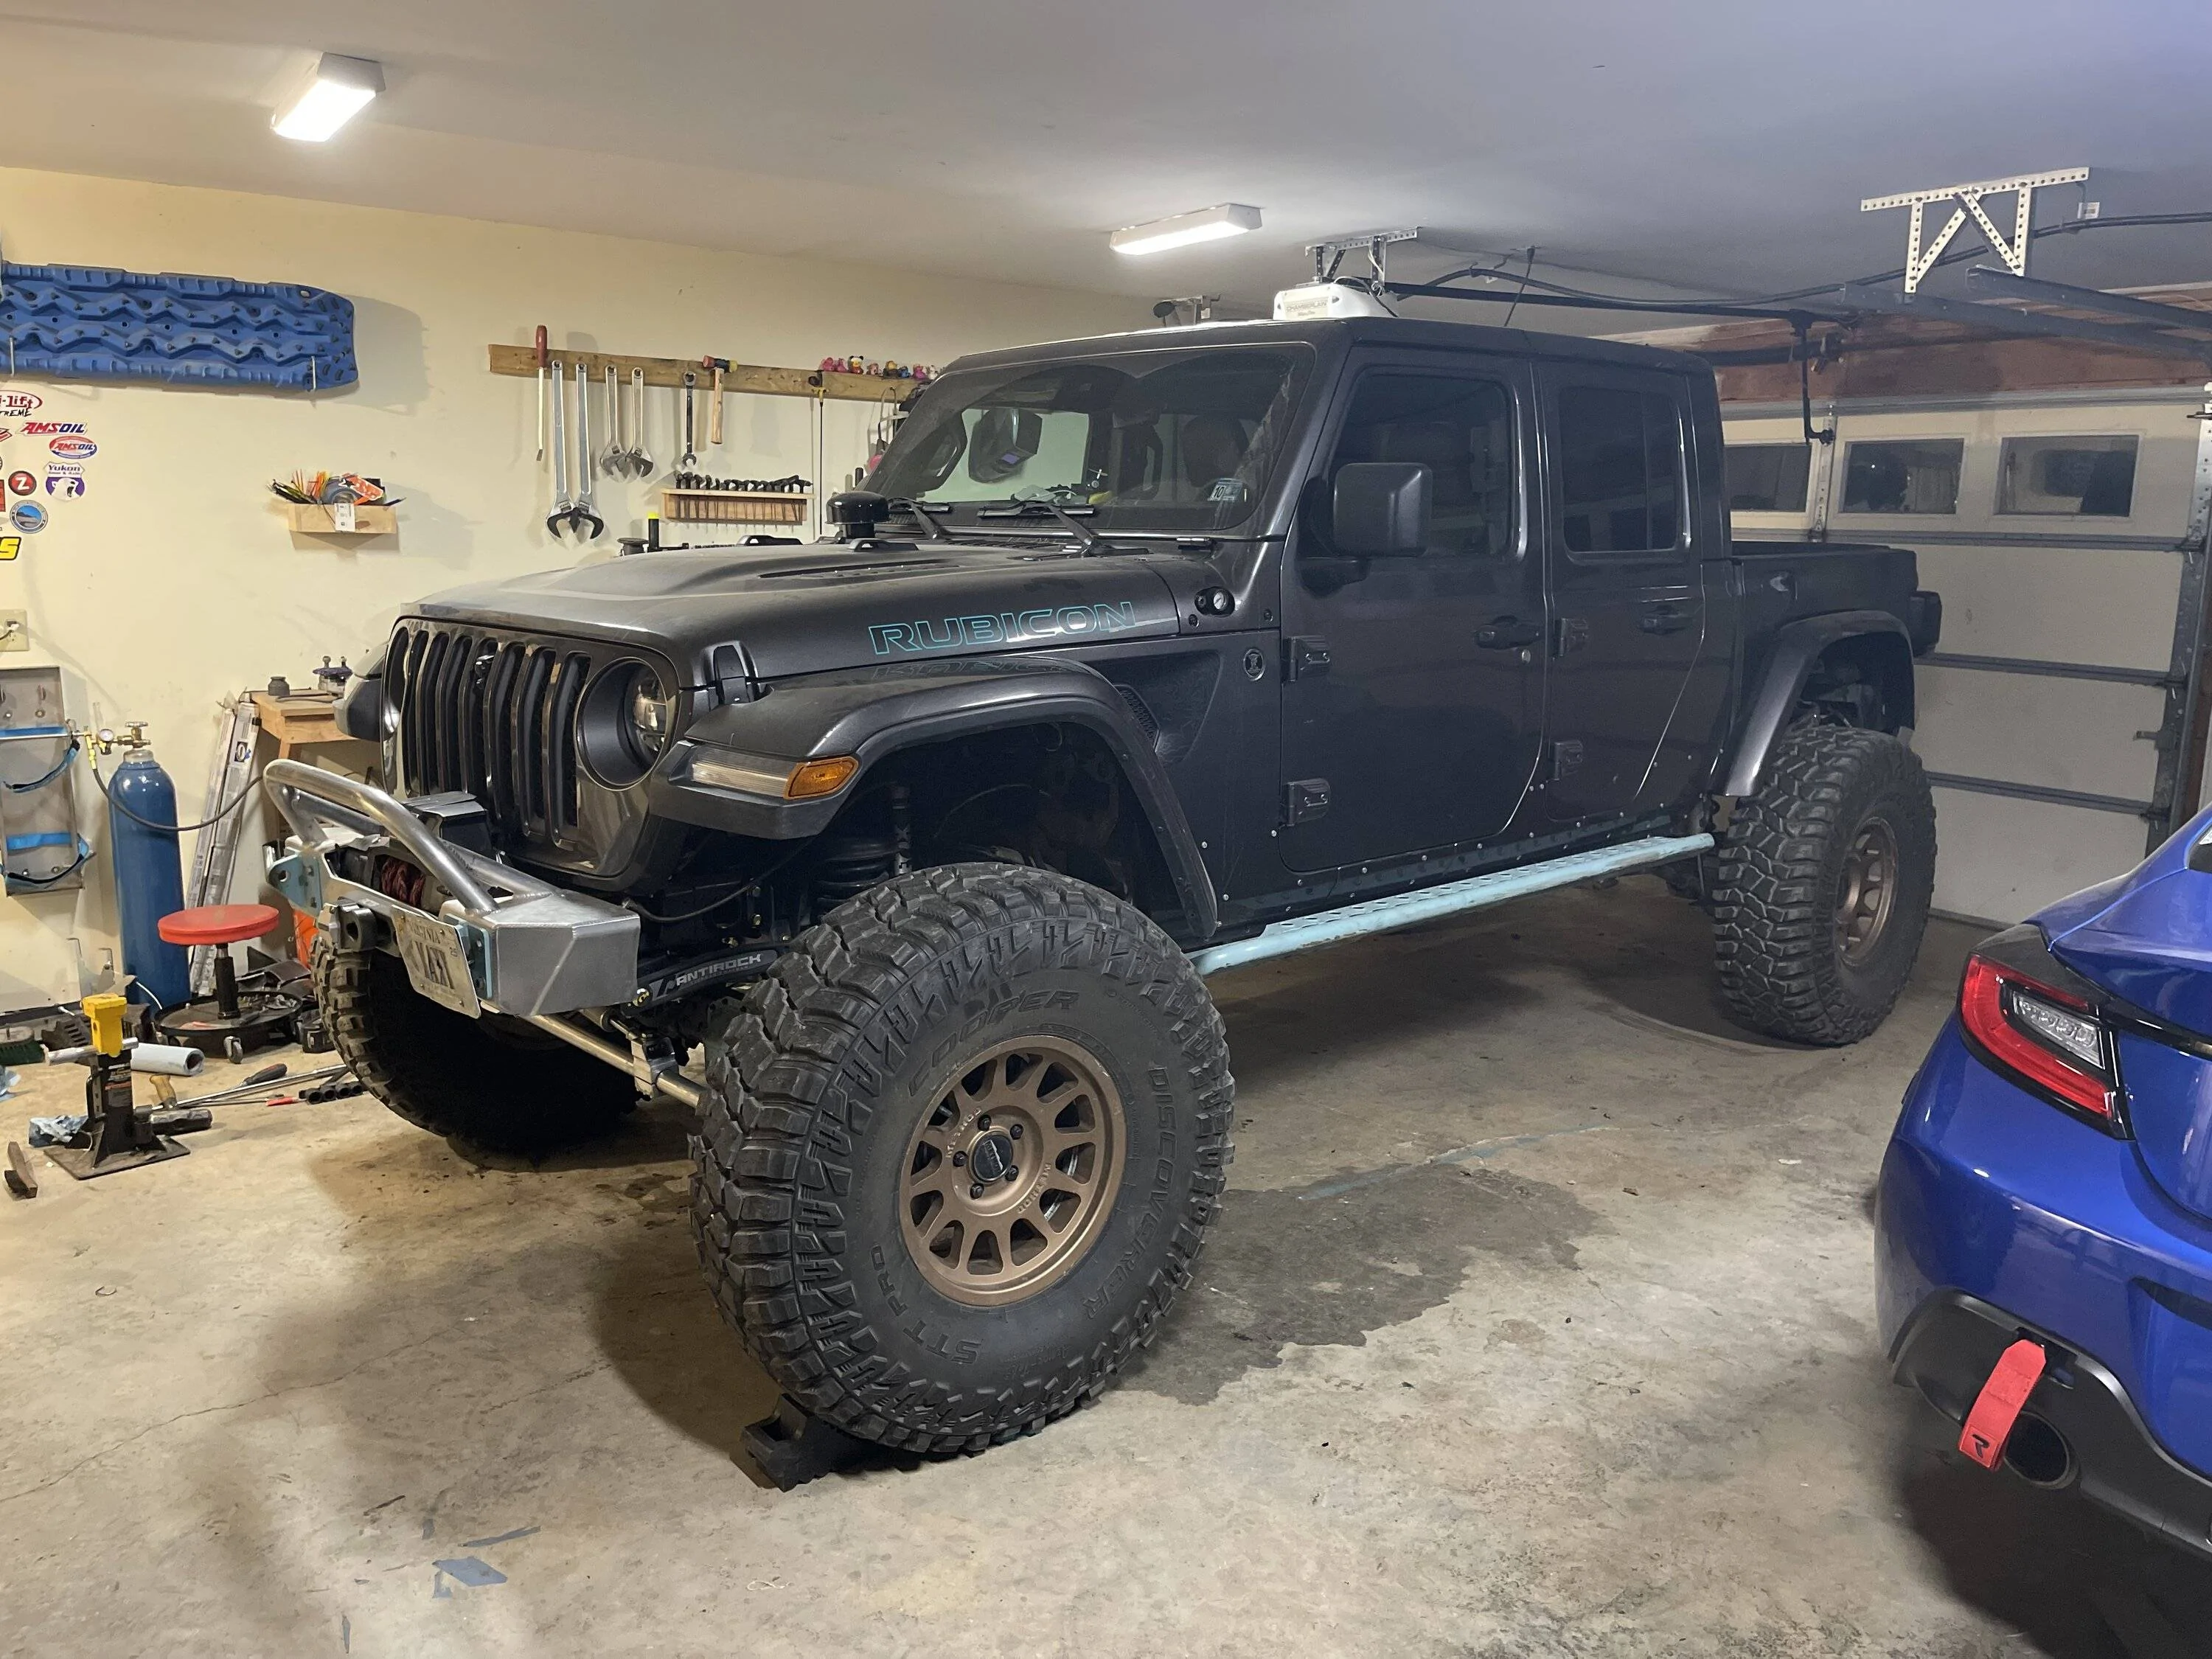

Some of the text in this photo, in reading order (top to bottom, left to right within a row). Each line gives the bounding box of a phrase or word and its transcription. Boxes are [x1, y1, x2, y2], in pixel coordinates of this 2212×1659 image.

[20, 422, 85, 434] AMSOIL
[55, 442, 95, 451] AMSOIL
[15, 476, 30, 490] Z
[1213, 486, 1225, 498] 10
[867, 601, 1137, 655] RUBICON
[675, 953, 762, 987] ANTIROCK
[908, 990, 1080, 1098] COOPER
[1082, 1067, 1177, 1319] DISCOVERER
[870, 1244, 982, 1364] STT PRO
